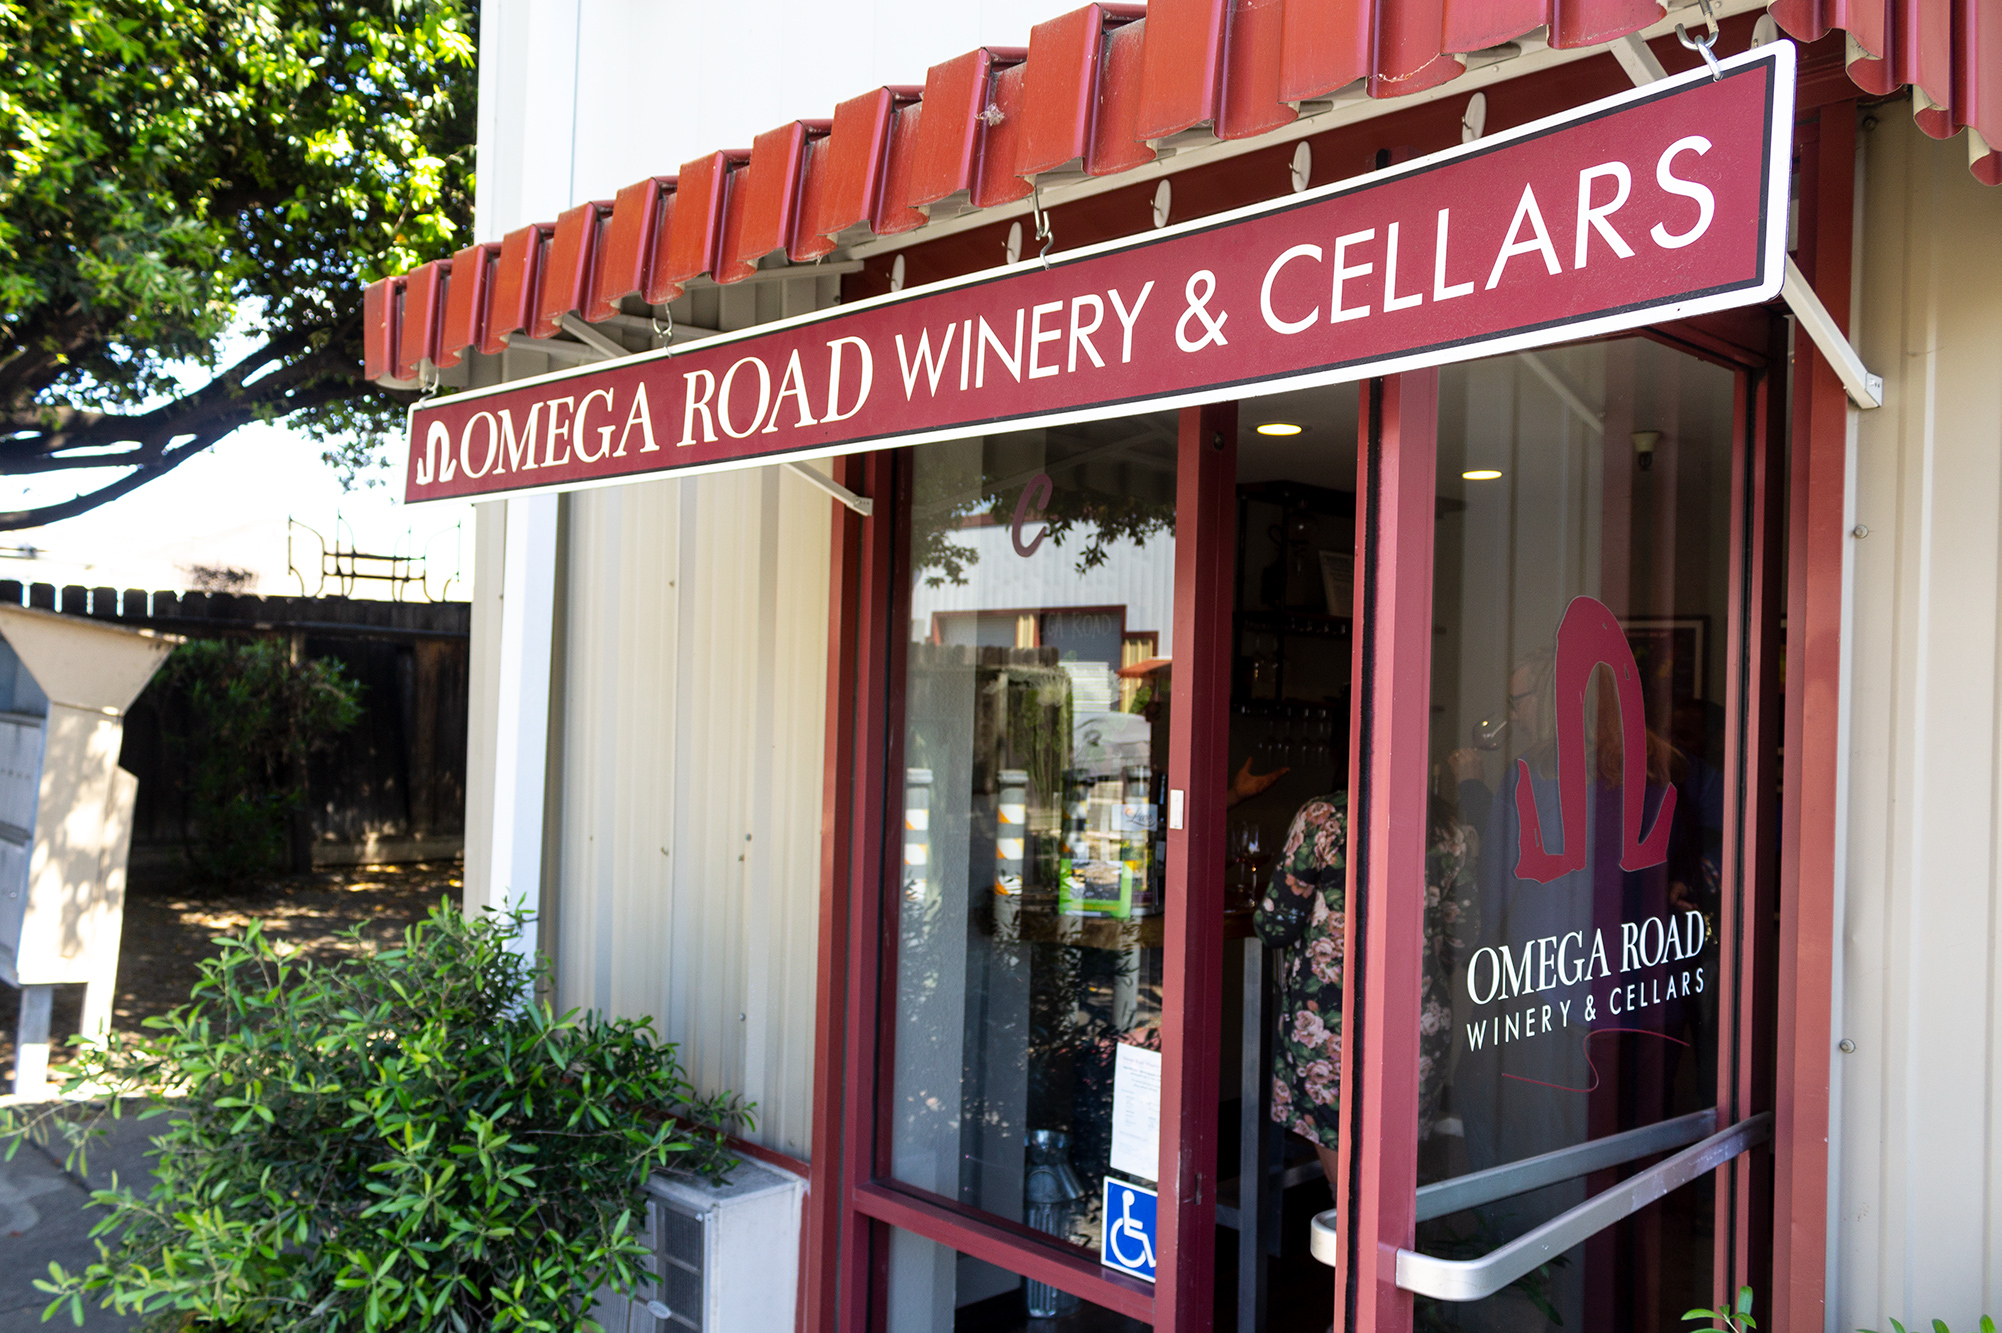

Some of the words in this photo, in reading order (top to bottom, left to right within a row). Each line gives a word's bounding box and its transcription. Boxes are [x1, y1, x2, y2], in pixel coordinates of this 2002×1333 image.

[459, 381, 660, 479] OMEGA
[676, 335, 874, 447] ROAD
[894, 280, 1156, 402] WINERY
[1174, 269, 1229, 353] &
[1259, 134, 1716, 335] CELLARS
[1466, 928, 1612, 1005] OMEGA
[1619, 910, 1706, 973] ROAD
[1466, 1000, 1572, 1052] WINERY
[1584, 994, 1597, 1022] &
[1609, 967, 1705, 1015] CELLARS
